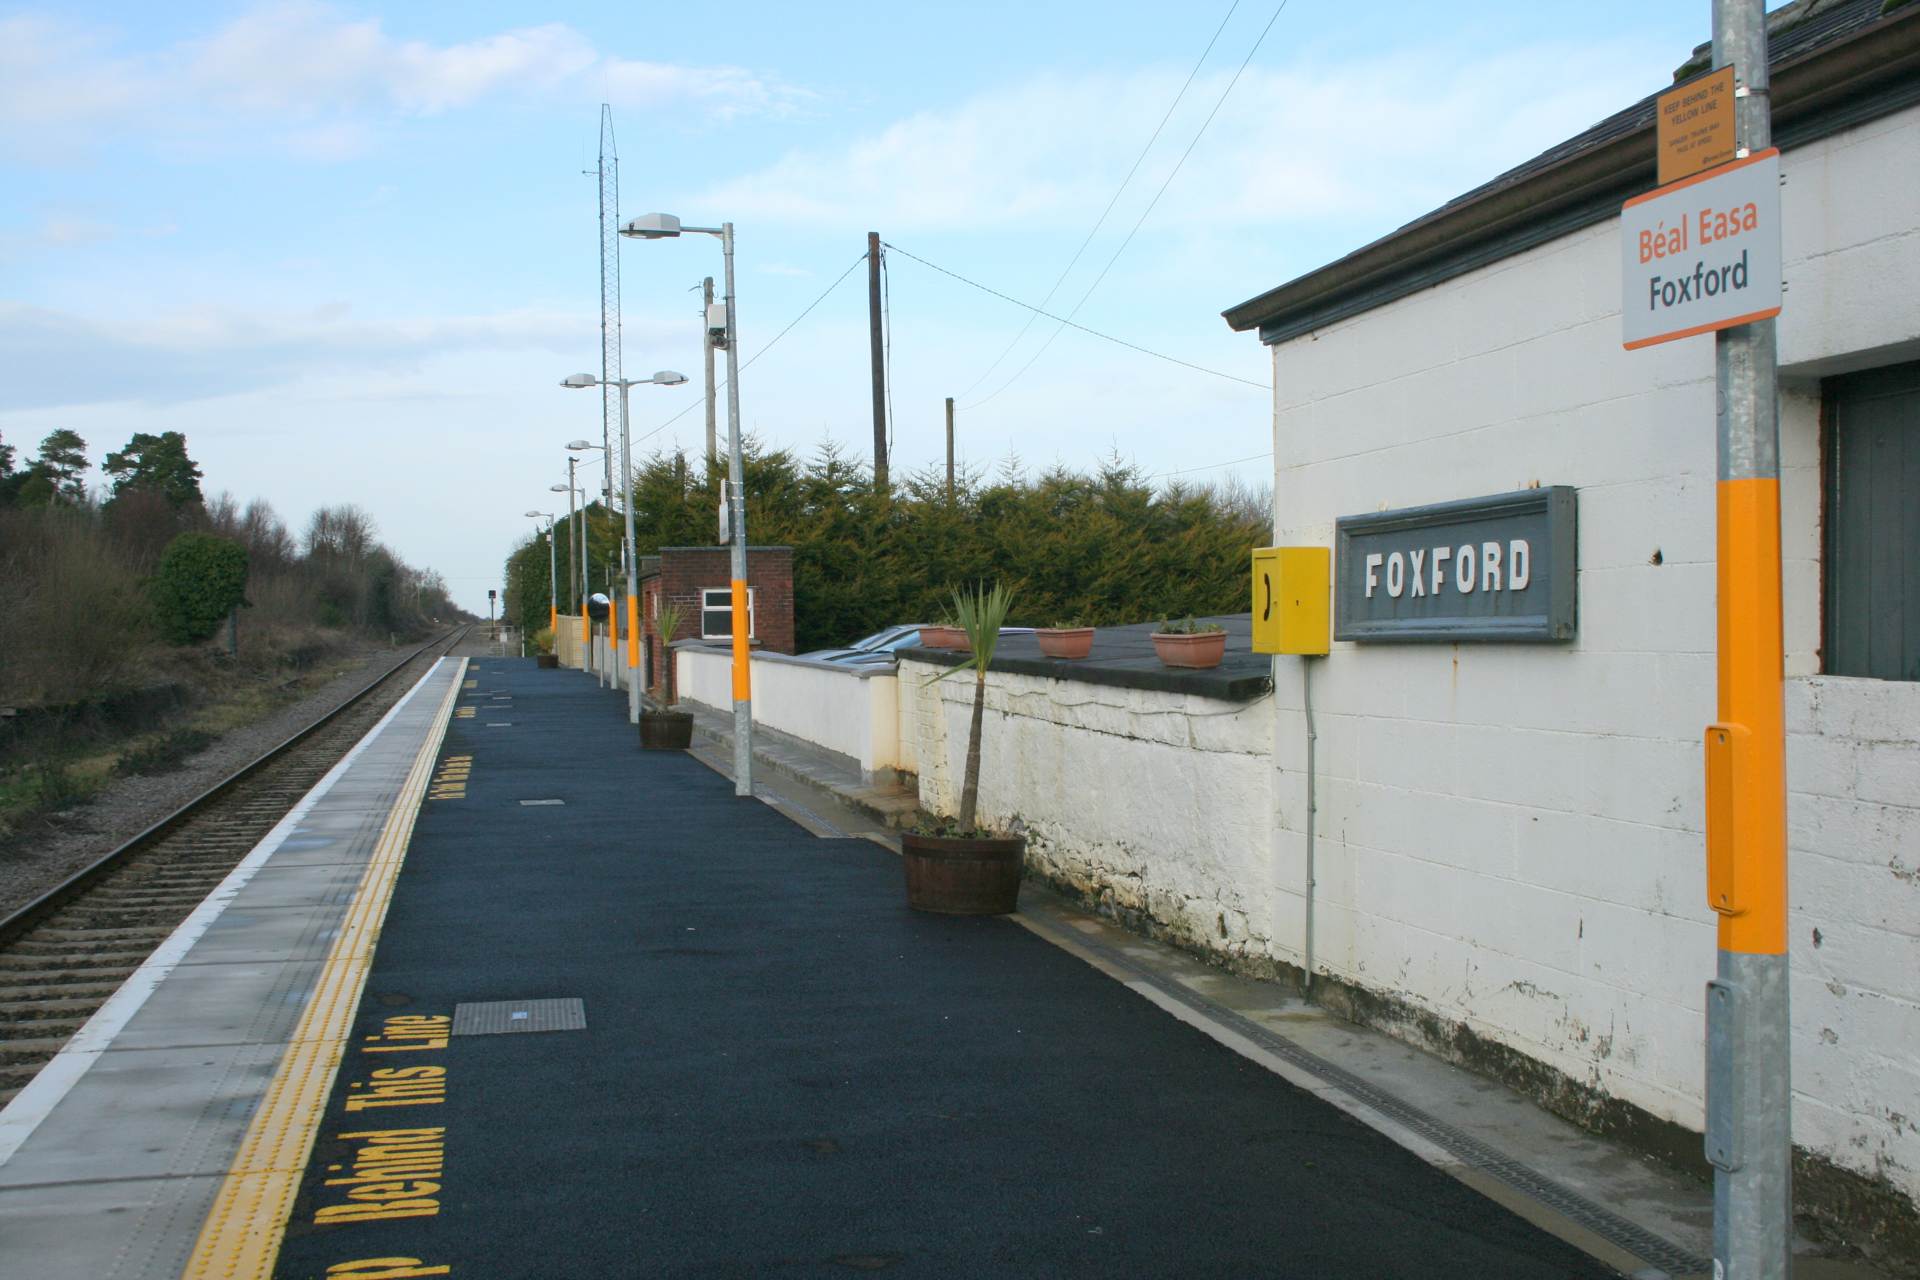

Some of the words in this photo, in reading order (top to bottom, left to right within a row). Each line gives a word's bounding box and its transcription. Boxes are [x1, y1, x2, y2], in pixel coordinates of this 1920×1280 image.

[1664, 101, 1680, 115] KEEP
[1682, 89, 1708, 107] BEHIND
[1711, 81, 1725, 95] THE
[1672, 106, 1699, 126] YELLOW
[1701, 99, 1717, 114] LINE
[1638, 213, 1688, 264] Béal
[1699, 202, 1758, 245] Easa
[1649, 249, 1748, 311] Foxford
[1365, 539, 1530, 598] FOXFORD
[361, 1015, 451, 1052] Line
[344, 1065, 448, 1111] This
[313, 1127, 446, 1224] Behind
